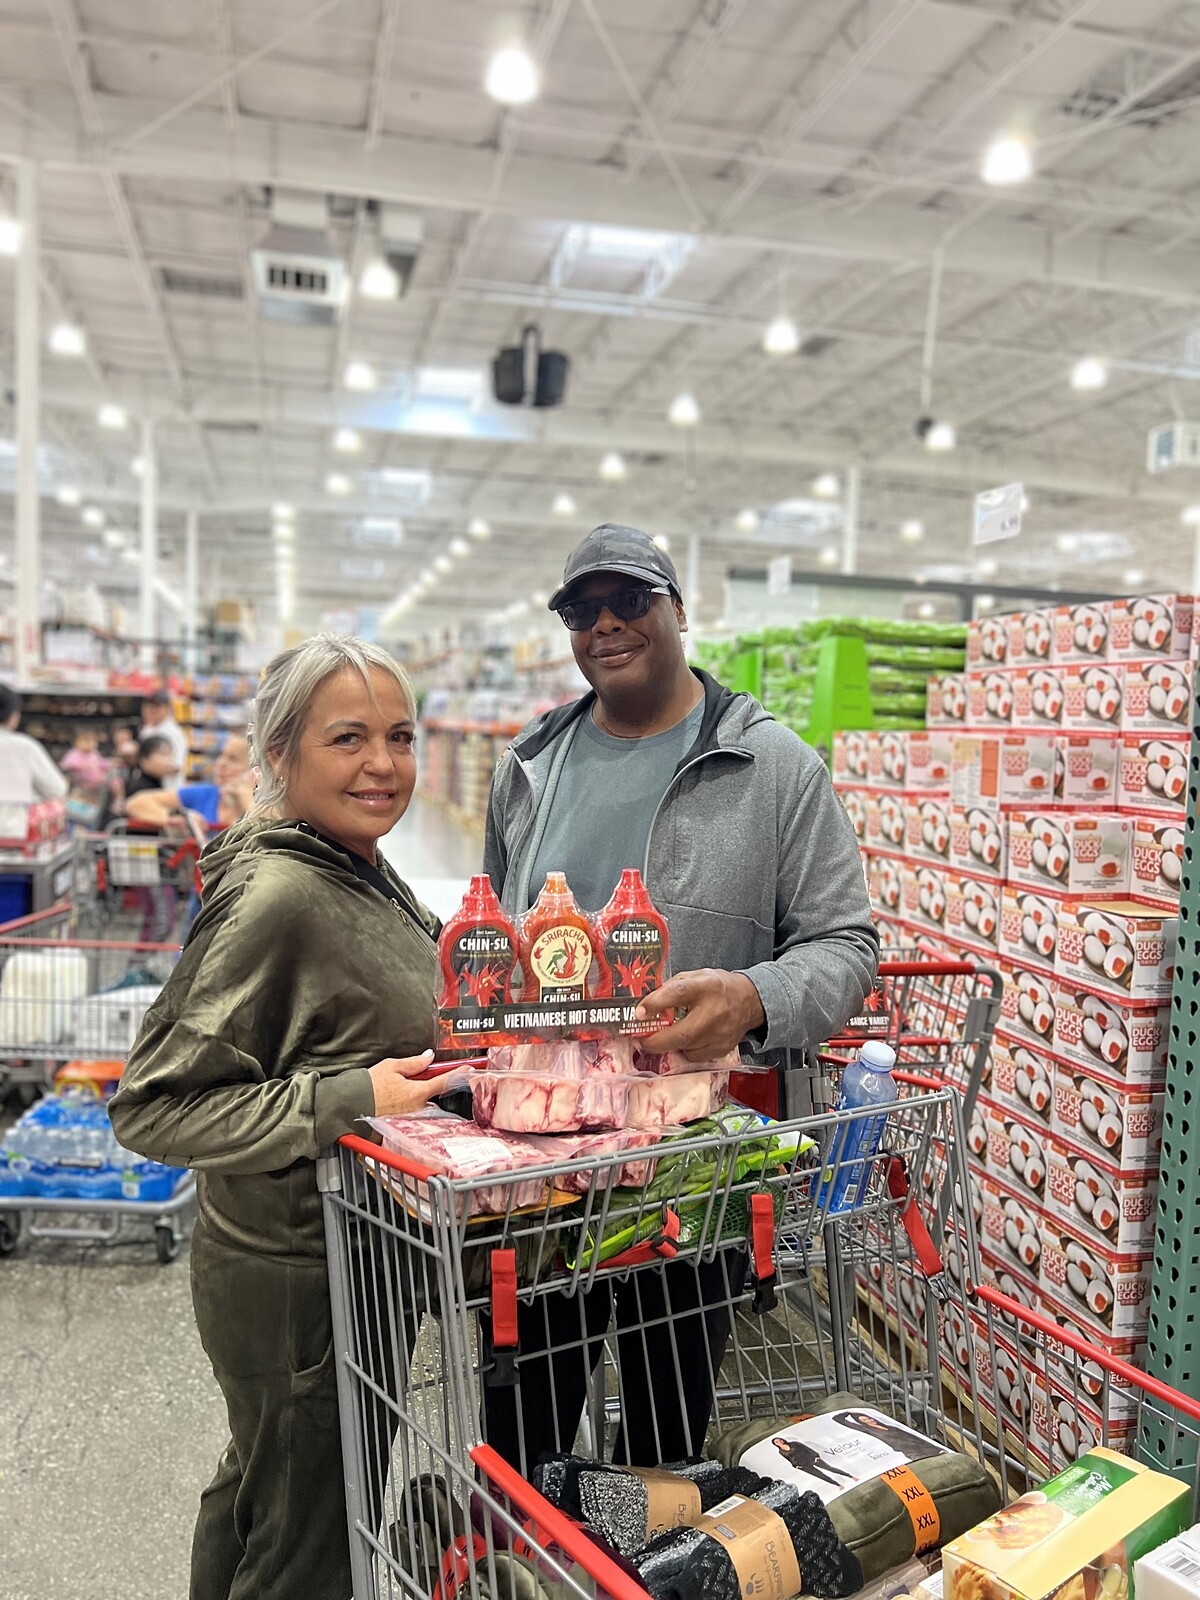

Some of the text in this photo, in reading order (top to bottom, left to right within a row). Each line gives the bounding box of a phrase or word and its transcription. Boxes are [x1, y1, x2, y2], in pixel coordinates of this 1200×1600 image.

[1121, 762, 1148, 774] DUCK
[1122, 772, 1146, 785] EGGS
[1073, 839, 1100, 849] DUCK
[1011, 846, 1032, 861] EGGS
[1074, 848, 1099, 858] EGGS
[1134, 846, 1162, 862] DUCK
[1134, 859, 1161, 874] EGGS
[460, 937, 509, 951] CHIN-SU
[542, 929, 585, 946] SRIRACHA
[612, 930, 660, 943] CHIN-SU
[1058, 928, 1085, 945] DUCK
[1058, 940, 1083, 957] EGGS
[1136, 941, 1164, 951] DUCK
[1136, 950, 1162, 960] EGGS
[456, 1018, 495, 1030] CHIN-SU
[504, 1010, 566, 1029] VIETNAMESE
[569, 1009, 587, 1024] HOT
[590, 1007, 620, 1023] SAUCE
[850, 1017, 868, 1026] SAUCE
[1055, 1007, 1084, 1027] DUCK
[1055, 1019, 1082, 1038] EGGS
[1132, 1027, 1160, 1037] DUCK
[1132, 1036, 1159, 1046] EGGS
[994, 1060, 1017, 1077] DUCK
[994, 1072, 1015, 1089] EGGS
[1055, 1087, 1082, 1110] DUCK
[1055, 1099, 1080, 1121] EGGS
[1127, 1113, 1154, 1124] DUCK
[1128, 1123, 1153, 1132] EGGS
[988, 1131, 1011, 1149] DUCK
[988, 1143, 1010, 1163] EGGS
[1048, 1165, 1076, 1188] DUCK
[1048, 1178, 1075, 1200] EGGS
[1123, 1198, 1150, 1208] DUCK
[1123, 1207, 1149, 1216] EGGS
[1042, 1245, 1068, 1269] DUCK
[1042, 1257, 1066, 1282] EGGS
[1117, 1283, 1145, 1292] DUCK
[1117, 1291, 1144, 1300] EGGS
[1033, 1399, 1061, 1431] DUK
[1033, 1411, 1059, 1440] EGS
[823, 1439, 862, 1456] Velour
[902, 1485, 925, 1502] XXL
[916, 1512, 936, 1531] XXL
